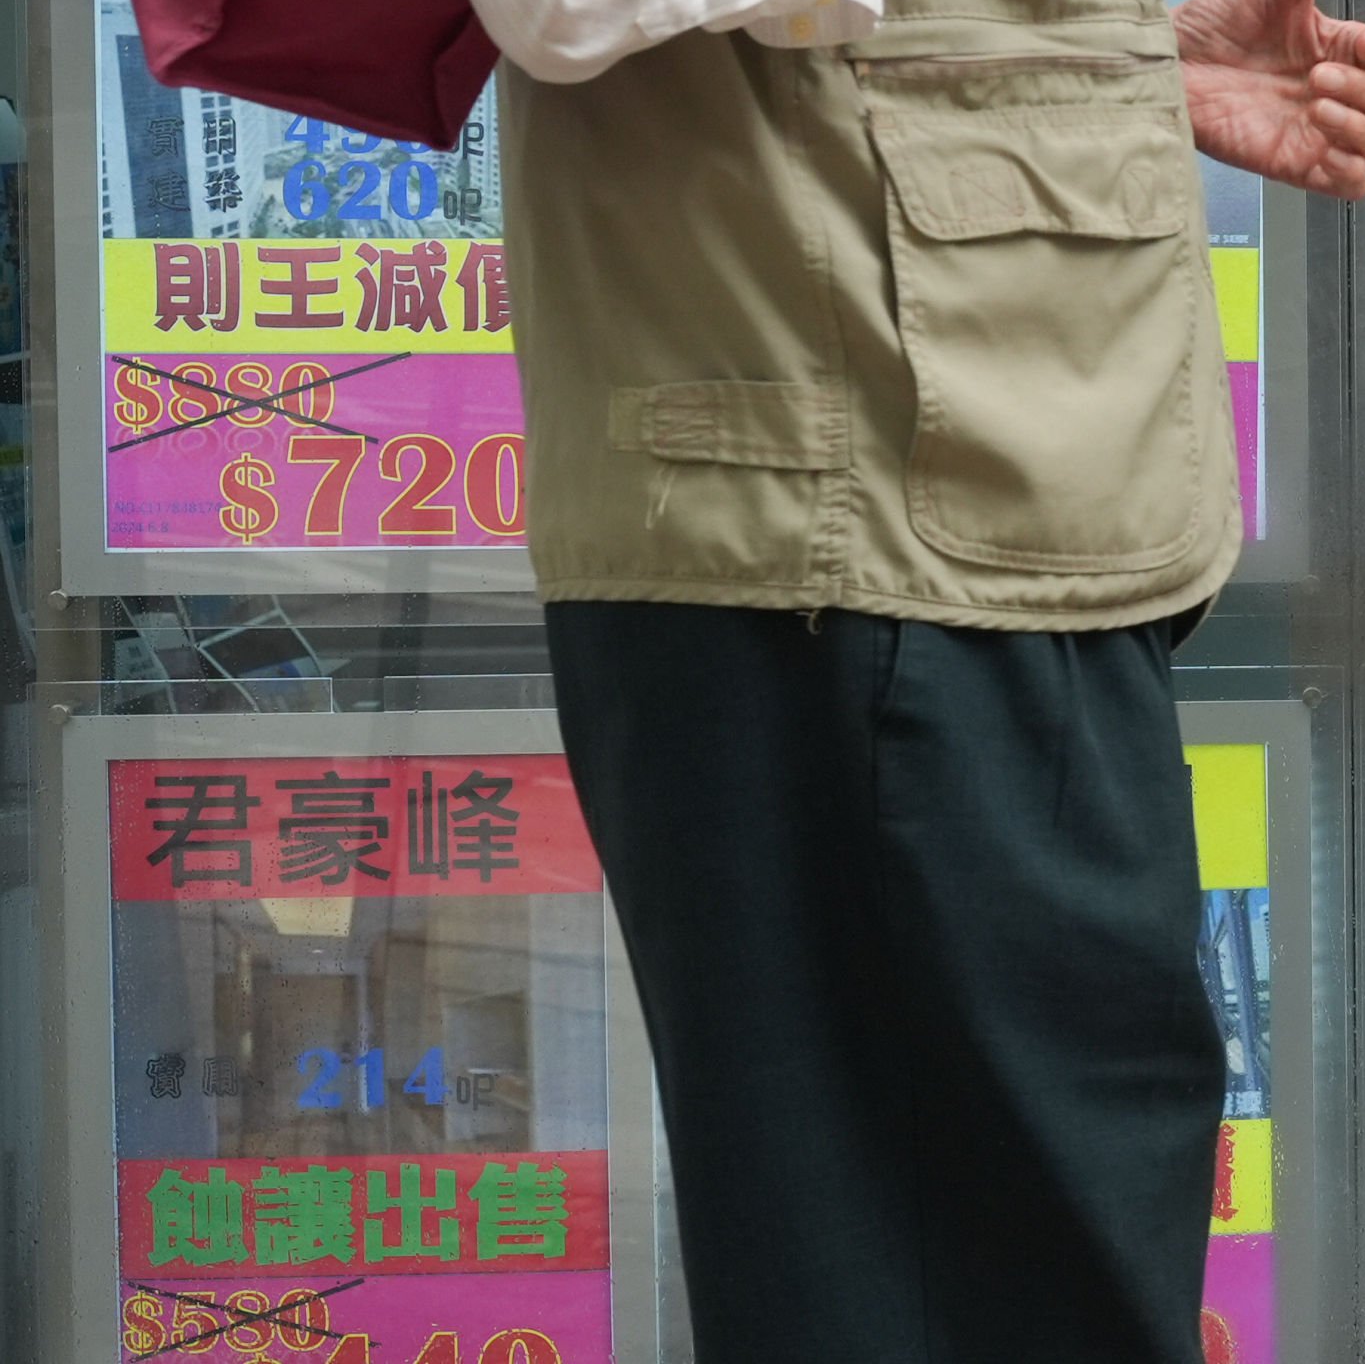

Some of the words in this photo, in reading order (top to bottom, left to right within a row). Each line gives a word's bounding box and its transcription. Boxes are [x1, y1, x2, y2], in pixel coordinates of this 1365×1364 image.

[281, 159, 439, 221] 620
[113, 355, 336, 434] $880
[218, 432, 525, 545] $720
[143, 770, 521, 888] 君豪峰
[295, 1046, 452, 1110] 214
[144, 1162, 571, 1268] 蝕讓出售
[122, 1287, 330, 1355] $580
